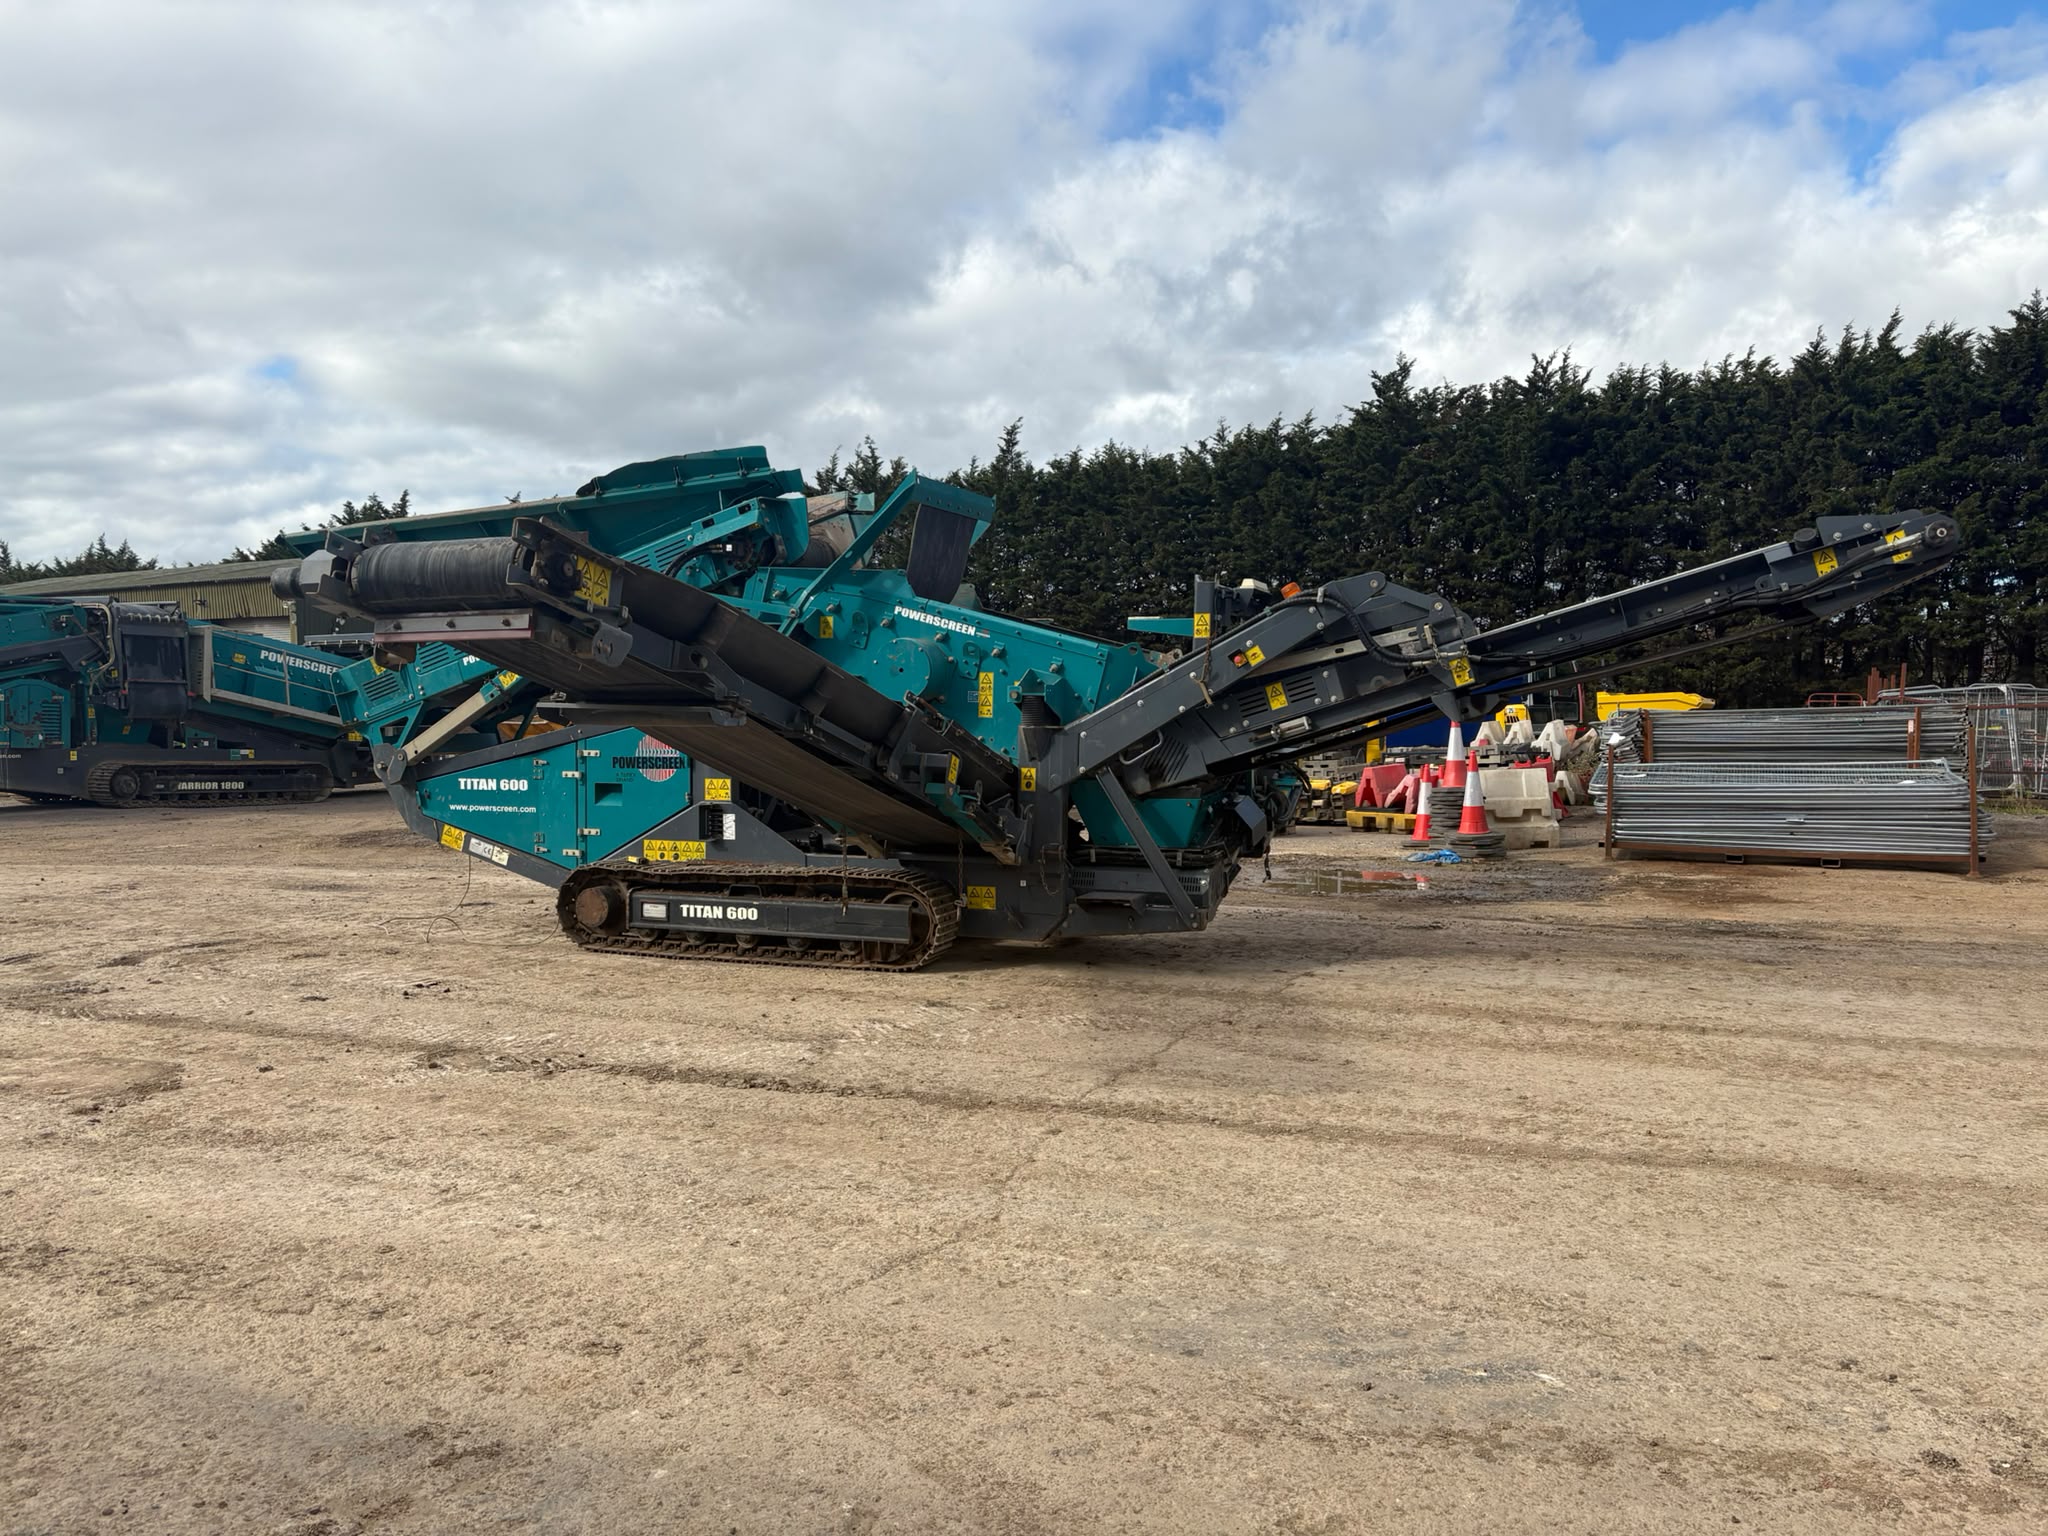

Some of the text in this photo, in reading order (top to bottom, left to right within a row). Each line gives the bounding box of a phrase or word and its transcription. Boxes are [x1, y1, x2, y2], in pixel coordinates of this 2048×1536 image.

[894, 605, 976, 636] POWERSCREEN
[612, 756, 686, 770] POWERSCREEN
[220, 781, 245, 790] 1800
[458, 778, 528, 791] TITAN 600
[449, 804, 536, 813] www.powerscreen.com
[680, 904, 723, 919] TITAN
[726, 906, 758, 920] 600
